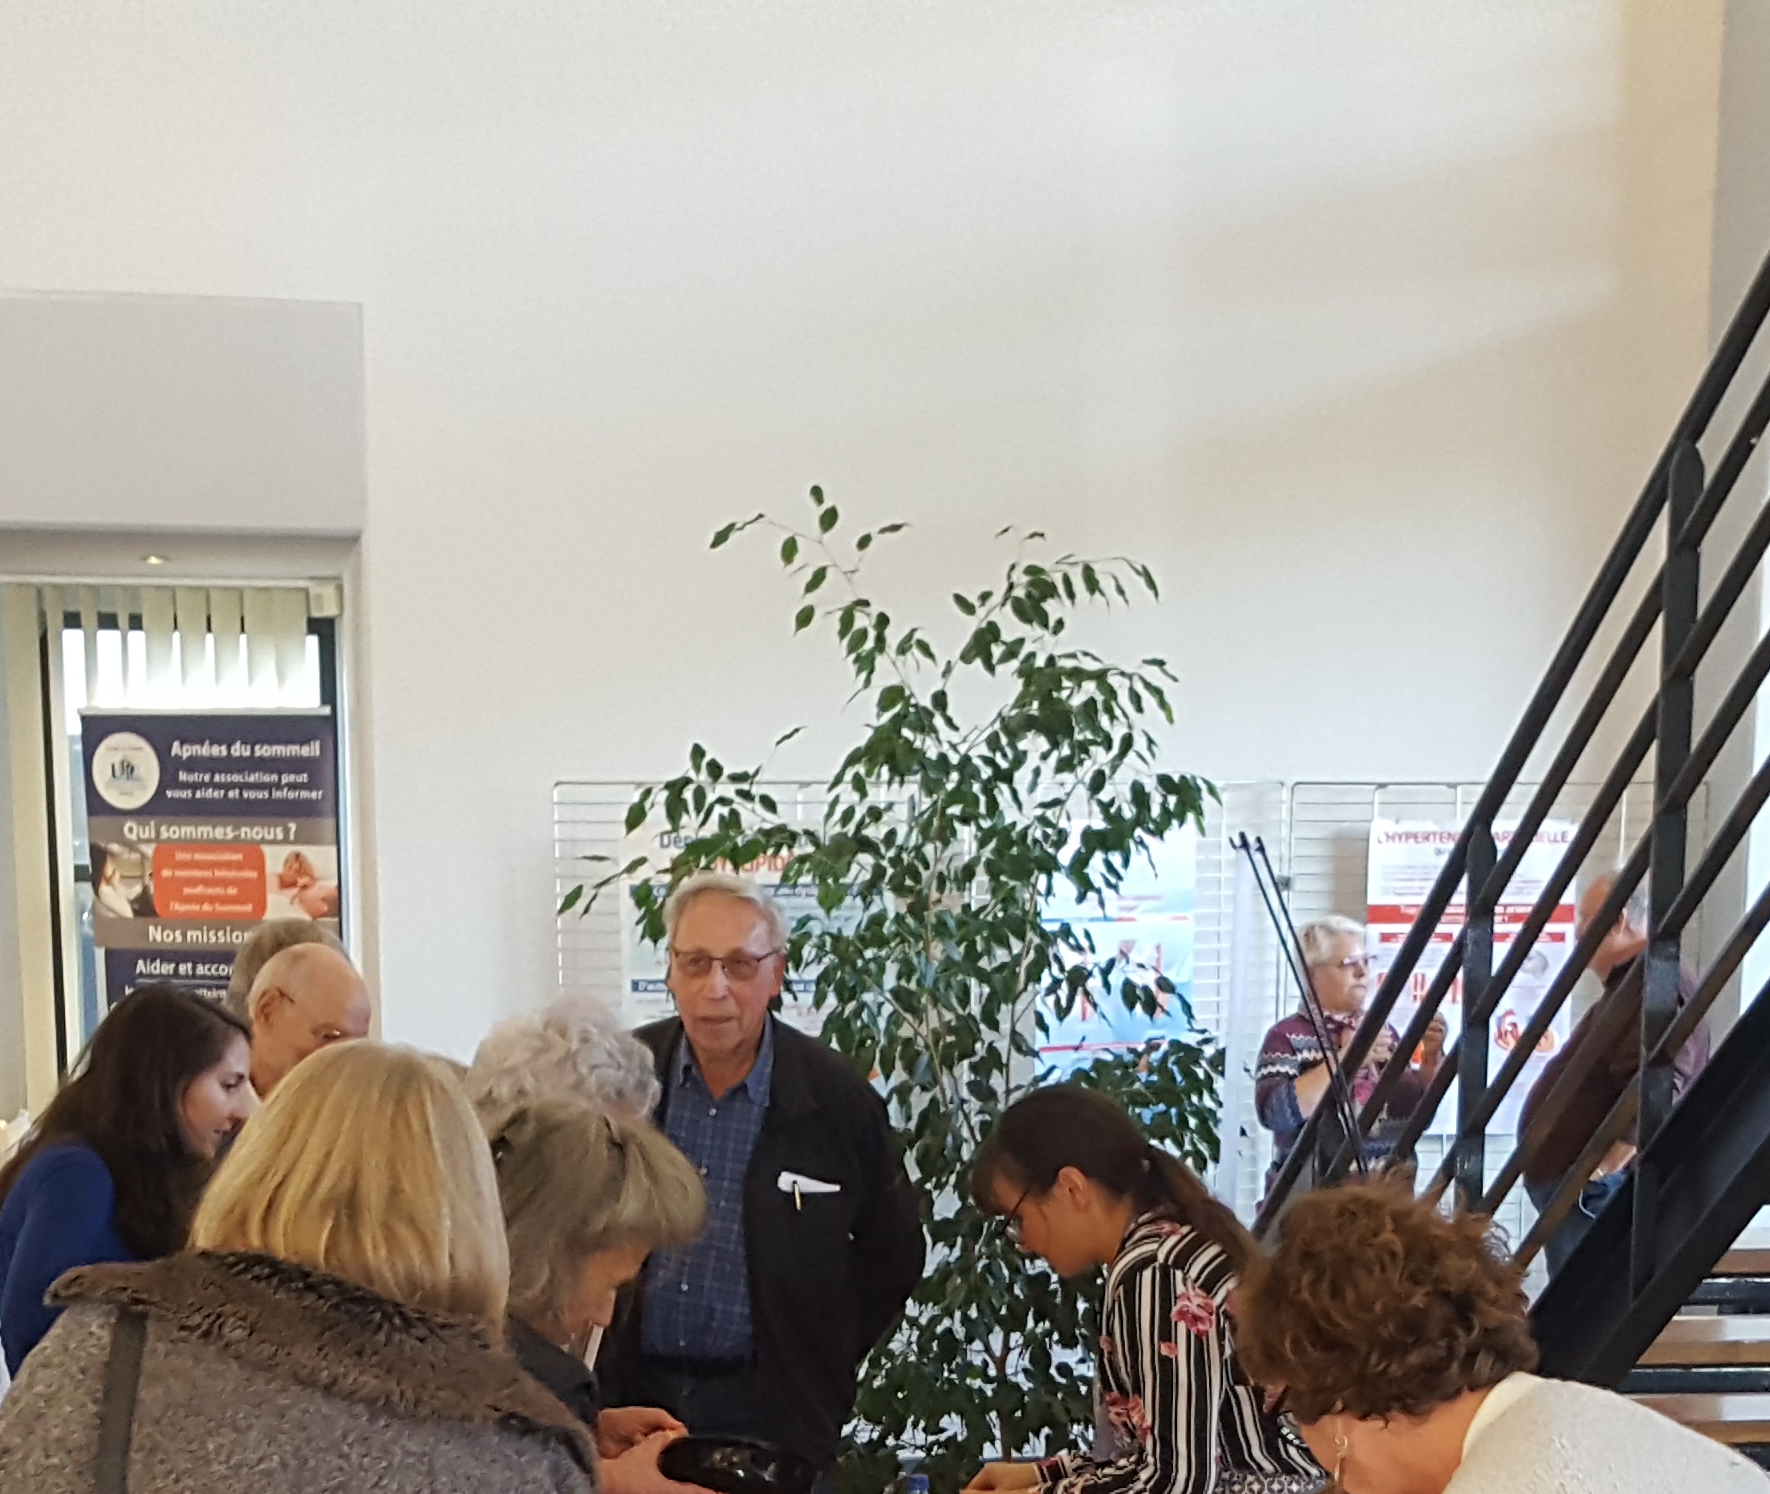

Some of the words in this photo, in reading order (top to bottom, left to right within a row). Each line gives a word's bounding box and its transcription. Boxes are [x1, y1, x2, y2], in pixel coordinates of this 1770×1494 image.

[170, 739, 228, 760] Apnées
[230, 740, 251, 757] du
[254, 739, 321, 757] sommeil
[178, 770, 211, 783] Notre
[213, 770, 278, 783] association
[281, 772, 309, 785] peut
[166, 789, 192, 799] vous
[195, 787, 225, 799] aider
[227, 788, 239, 799] et
[242, 788, 269, 799] vous
[272, 787, 323, 800] informer
[123, 820, 156, 840] Qui
[160, 823, 284, 840] sommes-nous
[287, 822, 296, 840] ?
[148, 925, 182, 943] Nos
[186, 925, 251, 943] mission
[135, 958, 176, 975] Aider
[179, 961, 193, 975] et
